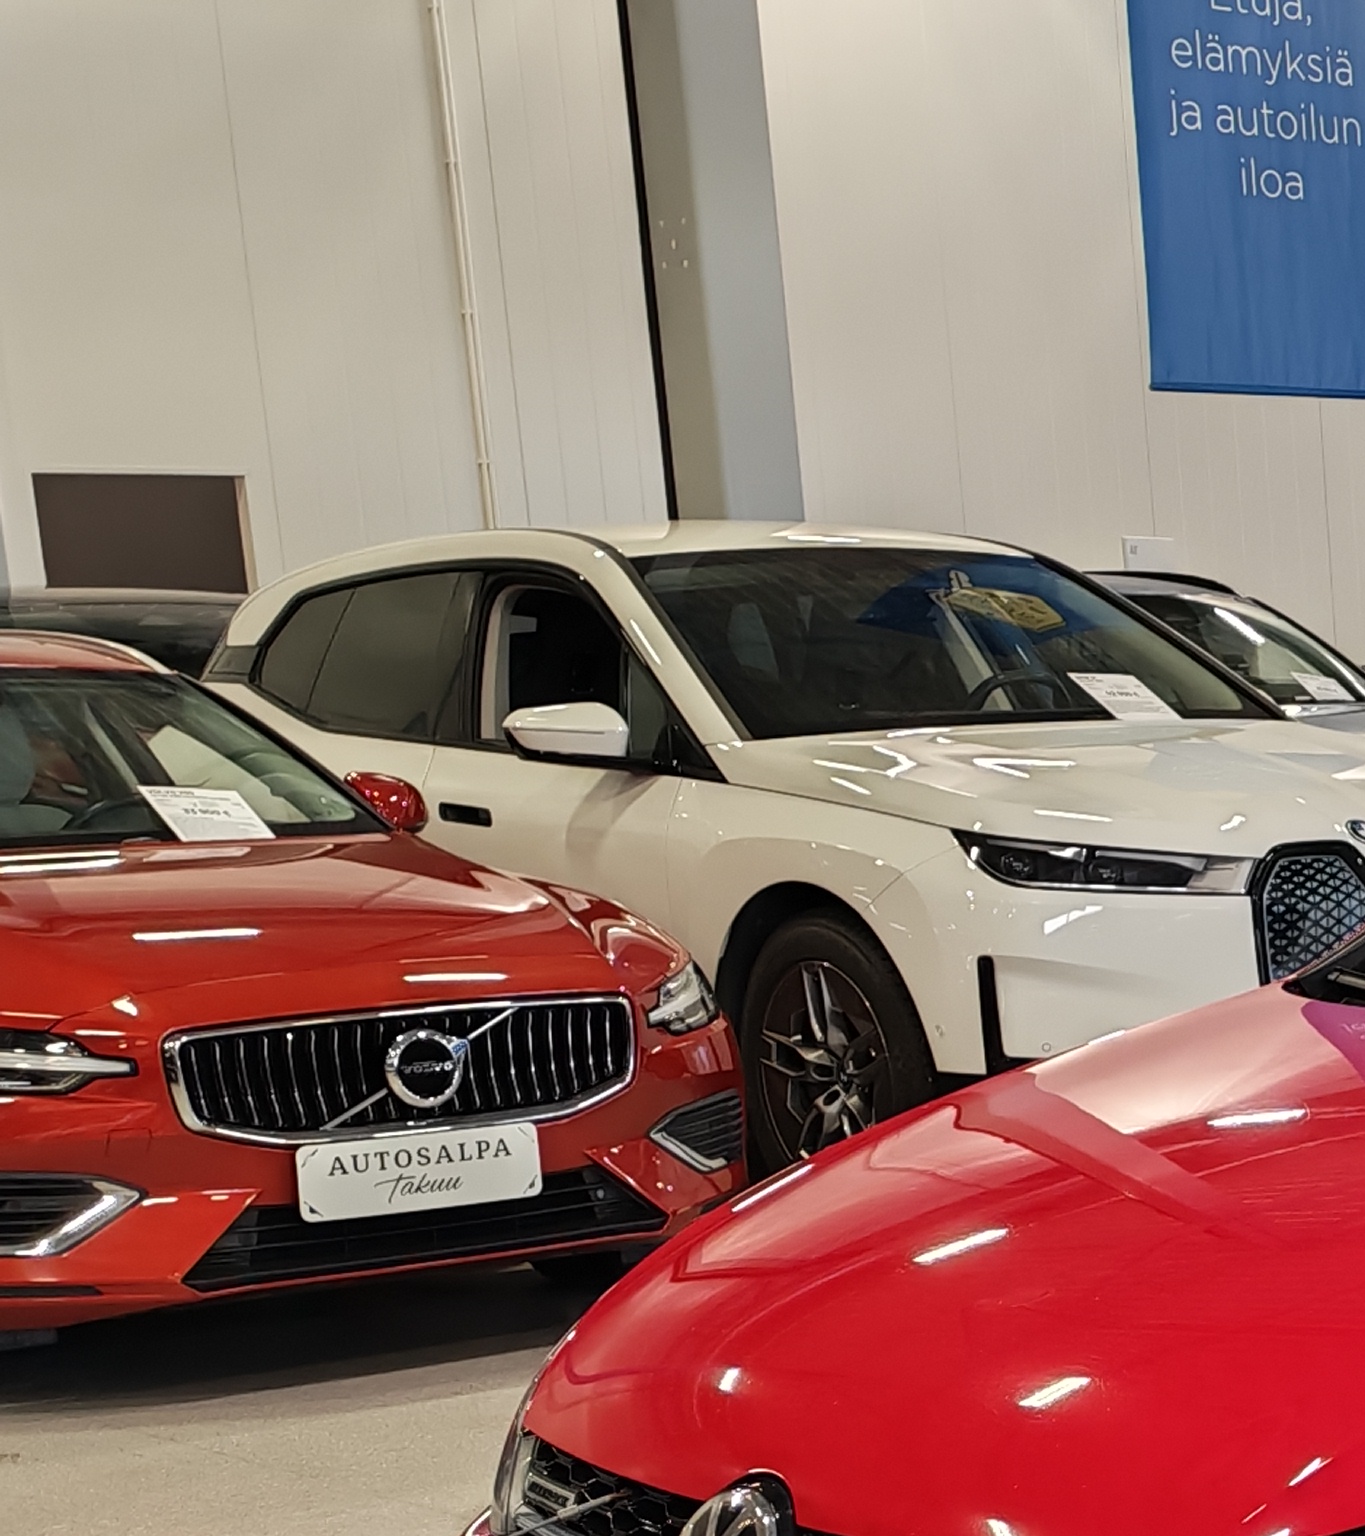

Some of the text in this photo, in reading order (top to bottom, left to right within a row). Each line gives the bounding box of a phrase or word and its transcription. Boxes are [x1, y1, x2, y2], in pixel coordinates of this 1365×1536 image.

[1170, 29, 1354, 86] elämyksiä
[1169, 88, 1362, 147] ja autoilun
[1240, 156, 1304, 200] iloa
[328, 1138, 512, 1176] AUTOSALPA
[374, 1173, 464, 1204] Takuu
